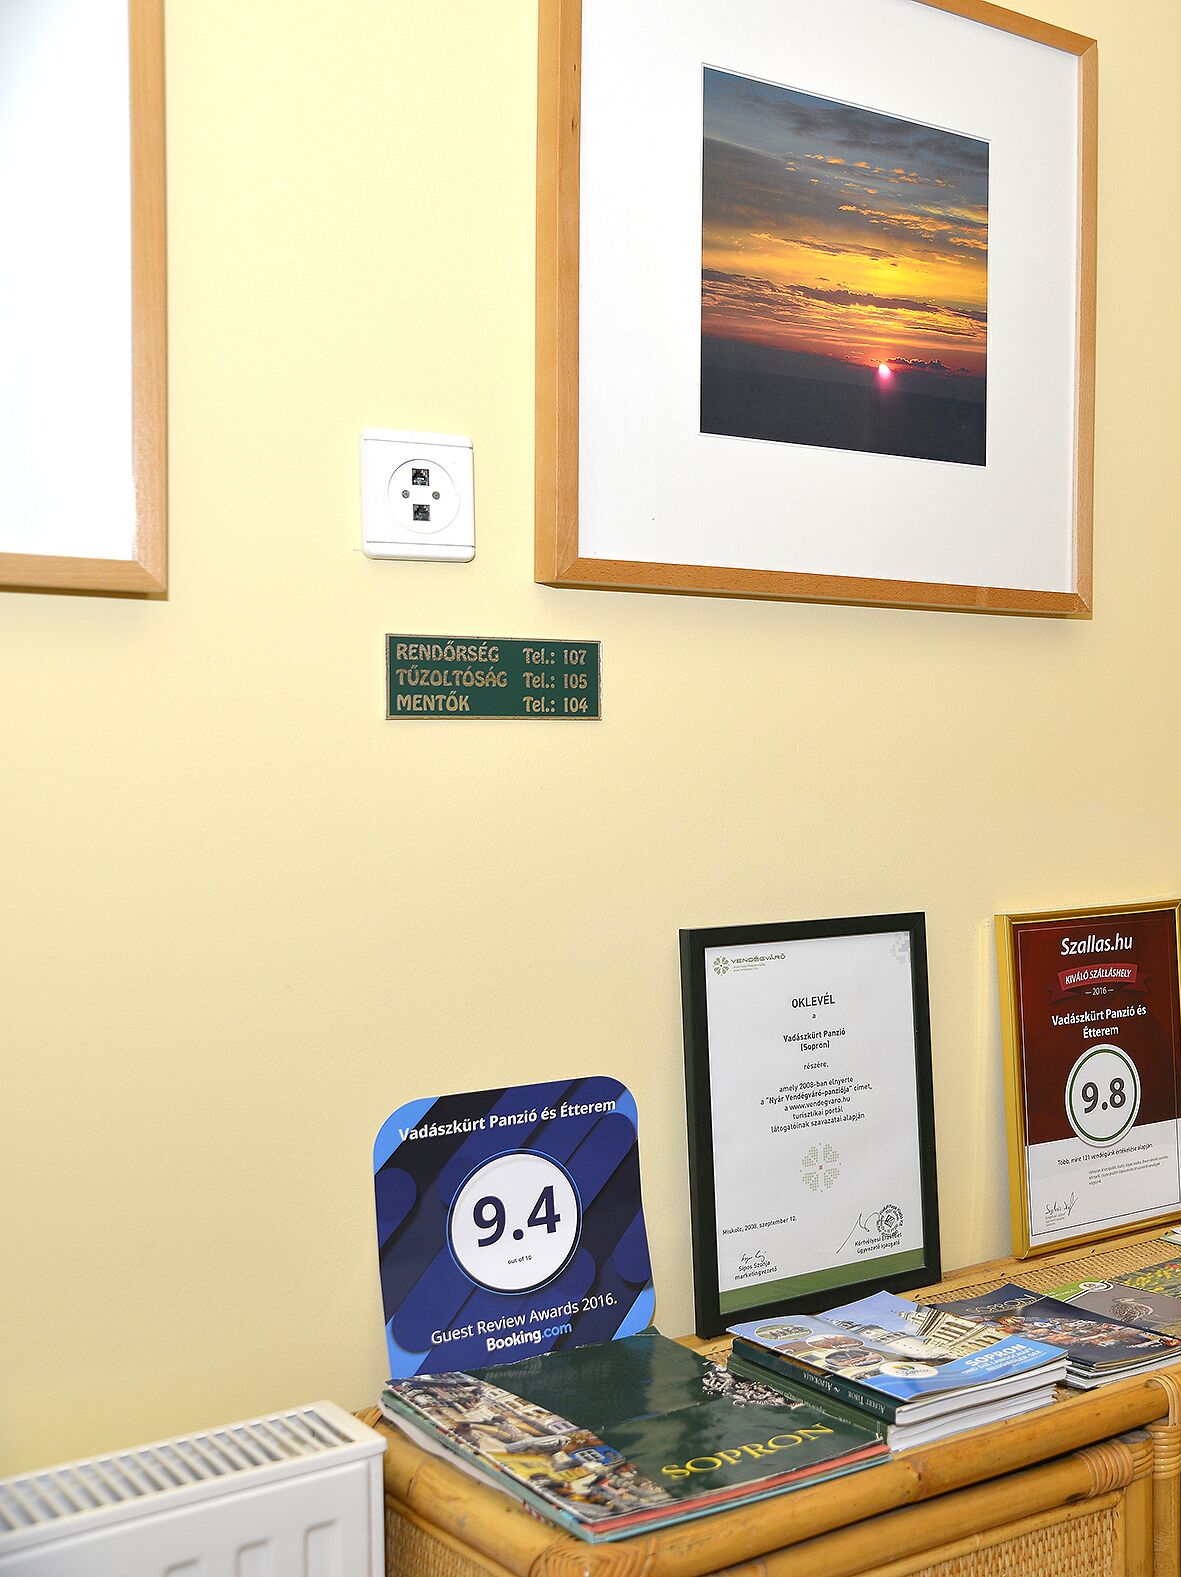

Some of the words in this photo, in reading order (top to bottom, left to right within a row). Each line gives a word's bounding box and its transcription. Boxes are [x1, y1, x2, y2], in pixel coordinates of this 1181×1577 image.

[396, 640, 500, 662] RENDŐRSÉG
[522, 647, 555, 665] Tel.:
[563, 649, 587, 665] 107
[396, 664, 508, 688] TŰZOLTÓSÁG
[522, 672, 555, 689] Tel.:
[563, 673, 588, 689] 105
[396, 690, 470, 712] MENTŐK
[522, 696, 555, 713] Tel.:
[563, 697, 588, 713] 104
[1060, 932, 1133, 956] Szallas.hu
[1065, 969, 1089, 985] KIVÁLÓ
[1089, 966, 1132, 980] SZÁLLÁSHELY
[791, 992, 836, 1009] OKLEVÉL
[1051, 1010, 1105, 1027] Vadászkürt
[1106, 1005, 1135, 1020] Panzió
[1136, 1004, 1147, 1016] és
[783, 1030, 823, 1044] Vadászkürt
[823, 1027, 846, 1039] Panzió
[1083, 1025, 1119, 1040] Étterem
[800, 1040, 830, 1052] (Sopron)
[779, 1085, 799, 1093] amely
[829, 1076, 854, 1086] elnyerte
[1081, 1077, 1127, 1114] 9.8
[398, 1116, 486, 1142] Vadászkürt
[489, 1107, 537, 1127] Panzió
[541, 1106, 557, 1121] és
[560, 1099, 616, 1118] Étterem
[770, 1121, 810, 1133] látogatóinak
[810, 1117, 842, 1127] szavazatai
[843, 1112, 866, 1122] alapján
[793, 1109, 824, 1121] turisztikai
[824, 1105, 844, 1116] portál
[472, 1185, 561, 1248] 9.4
[507, 1257, 518, 1265] out
[518, 1255, 525, 1263] of
[525, 1254, 533, 1262] 10
[431, 1323, 474, 1345] Guest
[477, 1314, 526, 1334] Review
[529, 1301, 580, 1323] Awards
[582, 1293, 618, 1312] 2016.
[486, 1321, 573, 1352] Booking.com
[965, 1343, 1028, 1367] SOPRON
[661, 1422, 834, 1481] SOPRON
